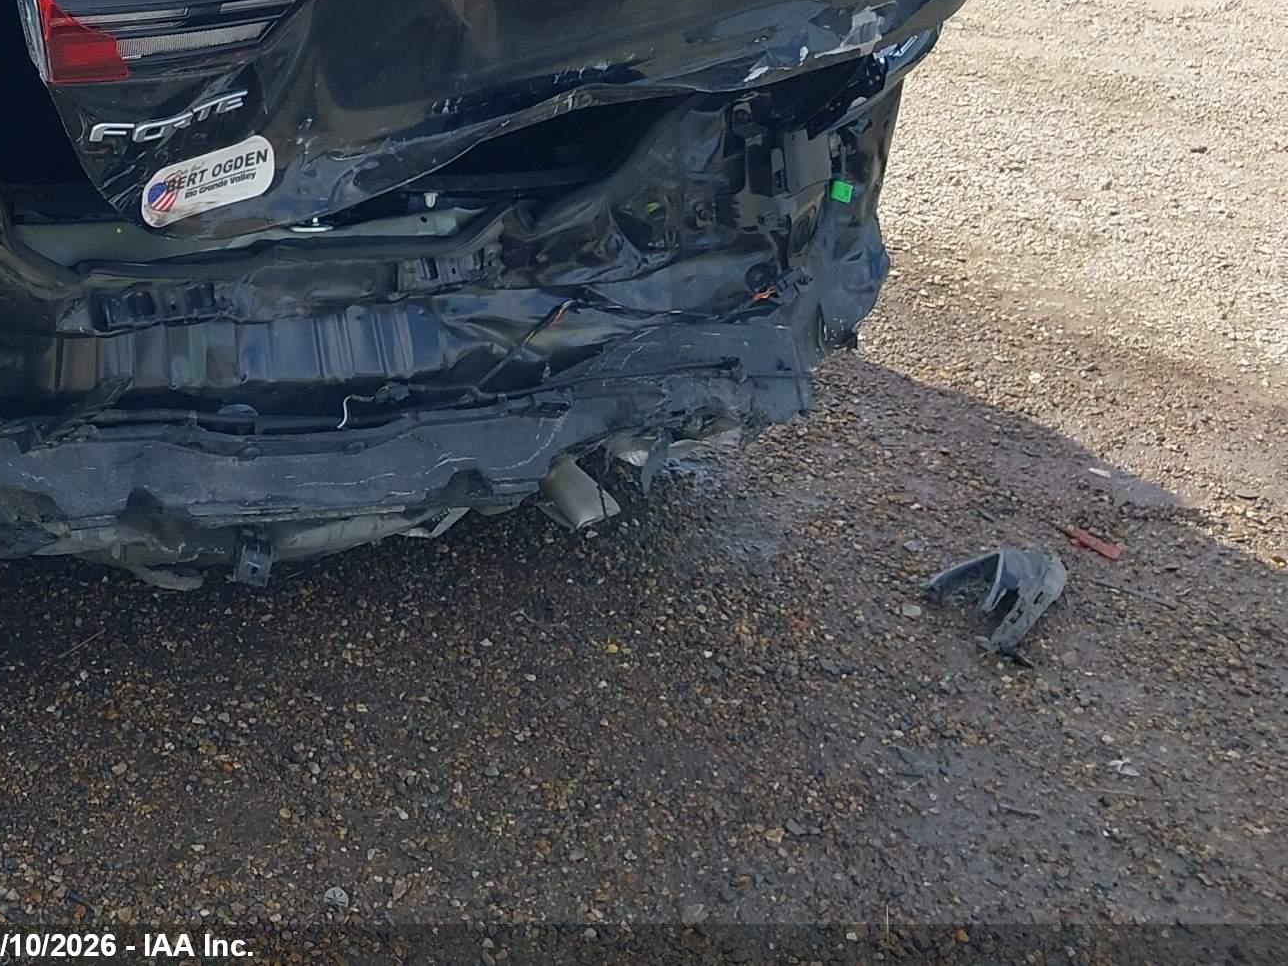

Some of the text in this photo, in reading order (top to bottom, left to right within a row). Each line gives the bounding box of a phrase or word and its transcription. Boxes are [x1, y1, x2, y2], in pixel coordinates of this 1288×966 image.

[89, 90, 249, 143] FORTE
[165, 168, 208, 194] BERT
[211, 148, 269, 178] OGDEN
[198, 179, 229, 195] Grande
[230, 171, 257, 186] Valley
